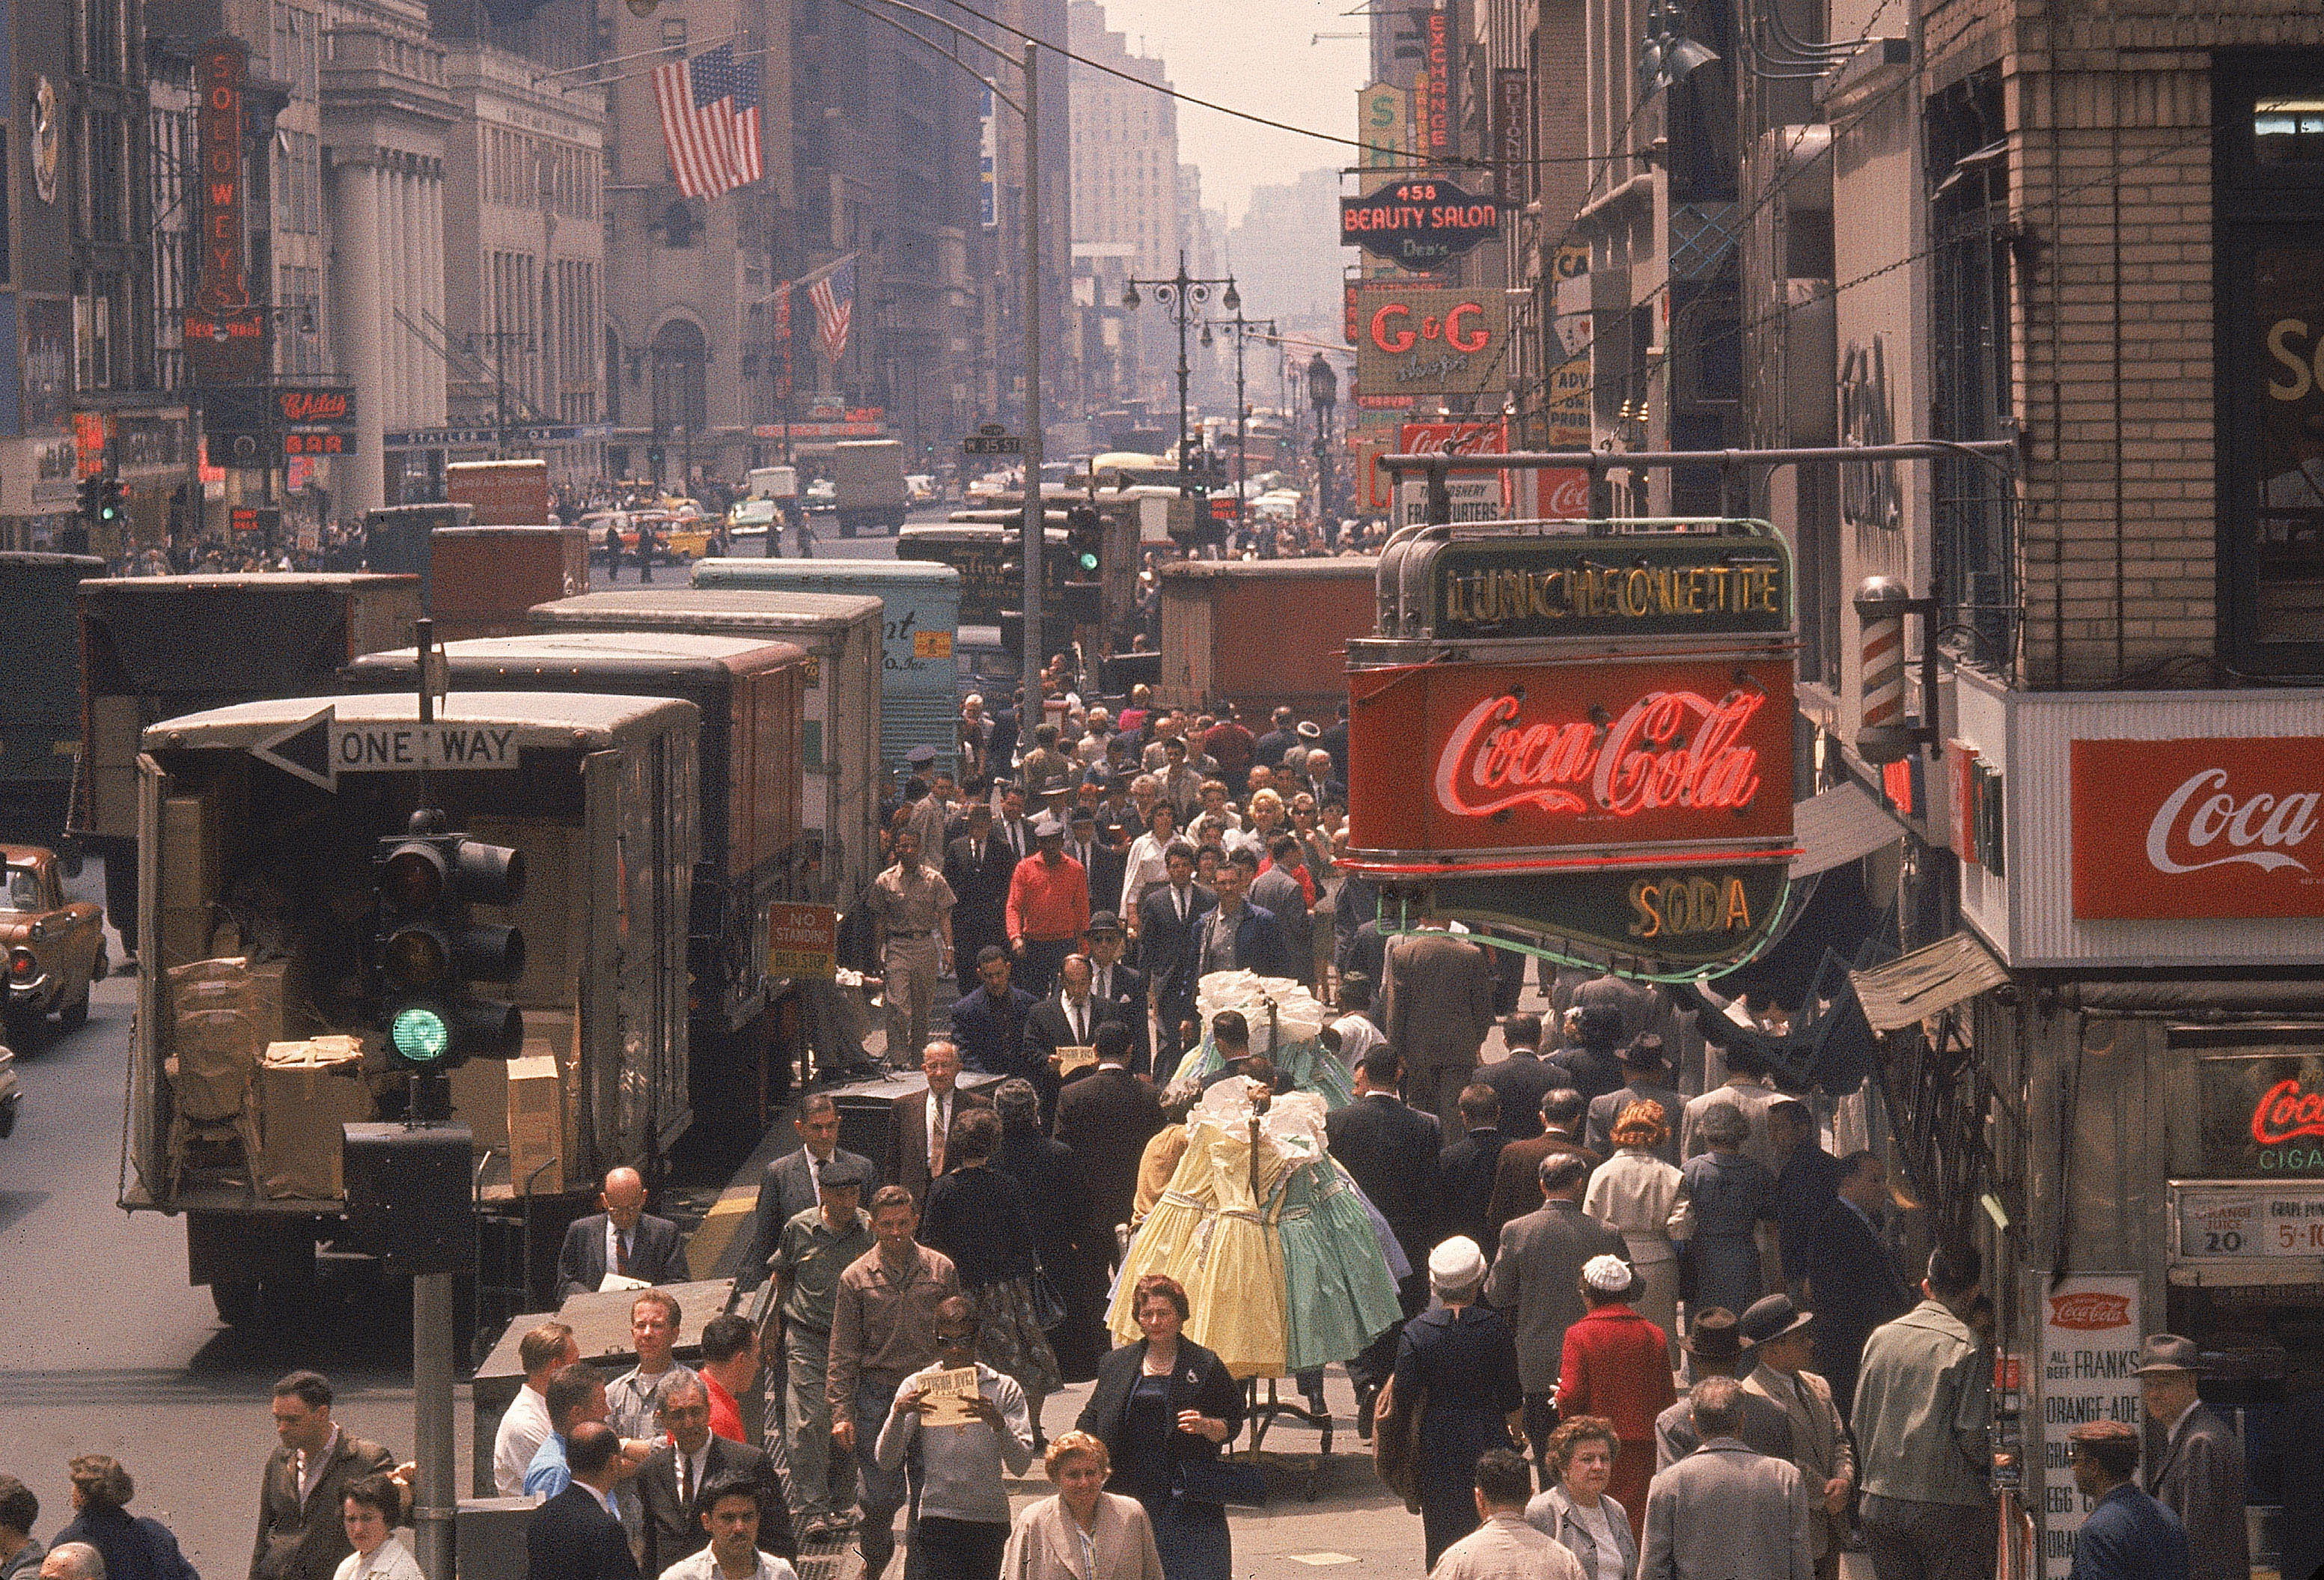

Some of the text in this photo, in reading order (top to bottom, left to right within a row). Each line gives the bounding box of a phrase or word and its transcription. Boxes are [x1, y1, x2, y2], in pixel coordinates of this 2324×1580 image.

[1429, 15, 1448, 146] EXCHANGE
[1397, 186, 1436, 202] 458
[1344, 205, 1495, 231] BEAUTY SALON
[286, 435, 342, 454] BAR
[408, 429, 551, 443] STATLER HON
[1407, 502, 1498, 522] FRAURTERS
[1448, 567, 1779, 621] LUNCHEONETTE
[342, 729, 513, 765] ONE WAY
[790, 912, 816, 927] NO
[1629, 877, 1751, 938] SODA
[776, 927, 829, 944] STANDING
[2206, 1232, 2242, 1252] 20
[2051, 1350, 2139, 1379] ALL FRANKS
[2046, 1397, 2140, 1424] ORANGE-ADE
[2047, 1486, 2073, 1513] EGG
